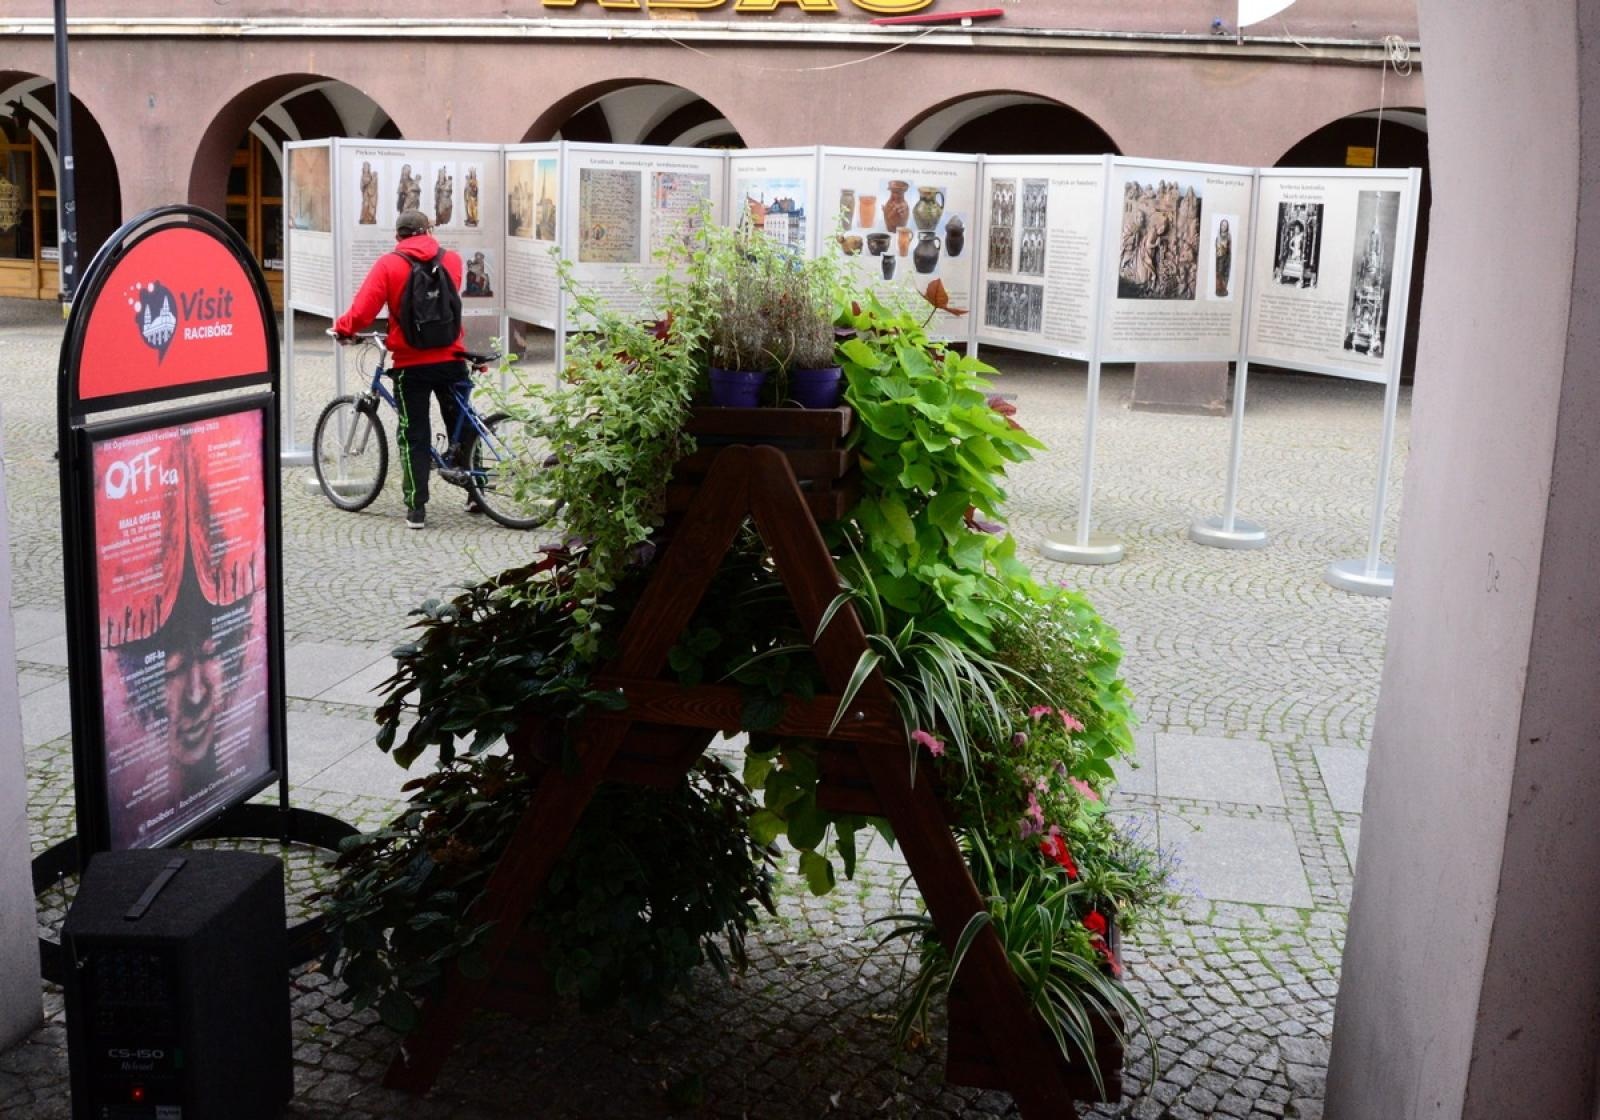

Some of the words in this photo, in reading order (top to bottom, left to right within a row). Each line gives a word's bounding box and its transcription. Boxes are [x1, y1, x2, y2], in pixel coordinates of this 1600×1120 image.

[180, 288, 233, 321] Visit
[184, 323, 233, 341] RACIBÓRZ
[107, 1049, 164, 1060] CS-150
